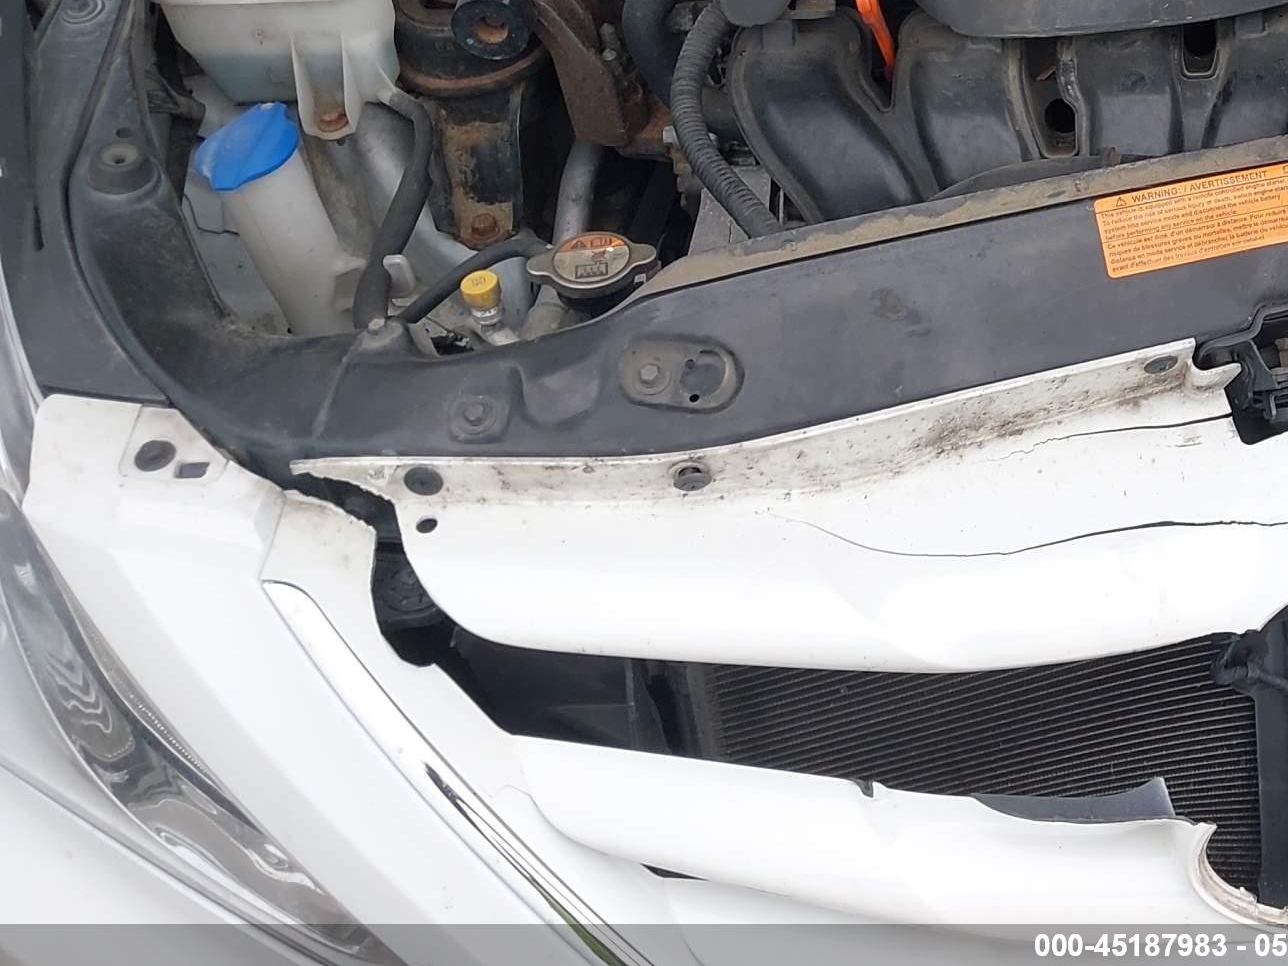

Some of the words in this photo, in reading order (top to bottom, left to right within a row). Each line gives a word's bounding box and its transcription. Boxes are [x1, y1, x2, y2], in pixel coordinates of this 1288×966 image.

[1132, 187, 1181, 202] WARNING:
[1188, 170, 1268, 191] AVERTISSEMENT
[1145, 200, 1172, 210] equipped
[1214, 186, 1243, 196] controlled
[1245, 182, 1265, 191] engine
[1103, 224, 1126, 234] system
[1140, 217, 1161, 226] service
[1193, 204, 1226, 215] disconnect
[1238, 198, 1259, 206] vehicle
[1260, 194, 1281, 203] battery
[1111, 215, 1132, 224] reduce
[1164, 205, 1186, 213] serious
[1187, 201, 1204, 209] injury
[1253, 188, 1273, 196] engine
[1249, 212, 1264, 220] Pour
[1105, 232, 1125, 240] before
[1126, 225, 1159, 237] performing
[1172, 218, 1194, 227] service
[1109, 248, 1131, 257] risques
[1141, 240, 1170, 250] blessures
[1232, 223, 1252, 231] mettre
[1110, 254, 1136, 264] distance
[1164, 244, 1185, 253] service
